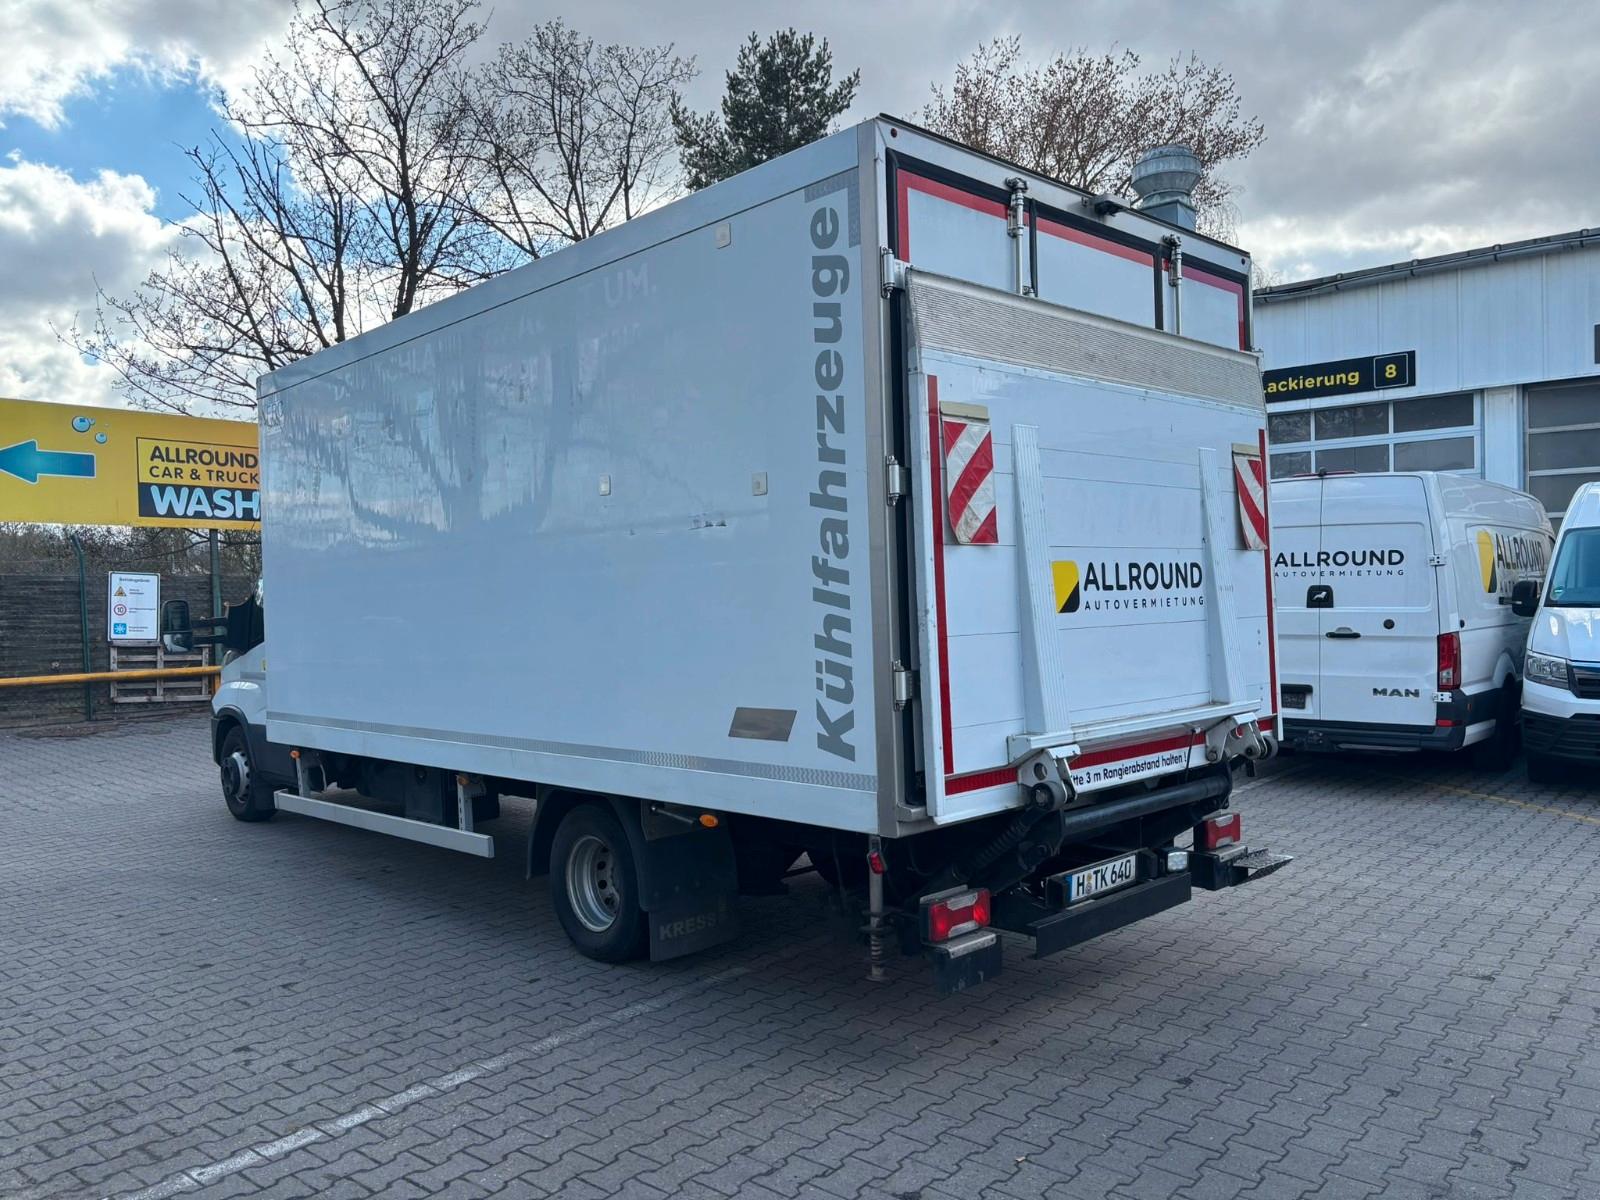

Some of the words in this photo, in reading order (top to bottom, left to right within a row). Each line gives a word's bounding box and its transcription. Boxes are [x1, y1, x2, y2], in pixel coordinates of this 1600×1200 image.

[1264, 371, 1360, 393] ackierung
[1385, 363, 1397, 378] 8
[150, 446, 259, 468] ALLROUND
[149, 466, 184, 479] CAR
[190, 468, 201, 480] &
[206, 469, 260, 484] TRUCK
[809, 206, 856, 762] Kühlfahrzeuge
[150, 485, 260, 519] WASH
[1274, 549, 1405, 568] ALLROUND
[1496, 533, 1545, 573] ALLROUND
[1083, 562, 1203, 591] ALLROUND
[1274, 569, 1404, 578] AUTOVERMIETUNG
[1084, 596, 1204, 611] AUTOVERMIETUNG
[1372, 687, 1420, 698] MAN
[1071, 774, 1085, 786] tte
[1085, 771, 1092, 783] 3
[1093, 771, 1102, 782] m
[1103, 756, 1160, 780] Rangierabstand
[1161, 752, 1183, 766] halten
[1110, 859, 1132, 884] 640
